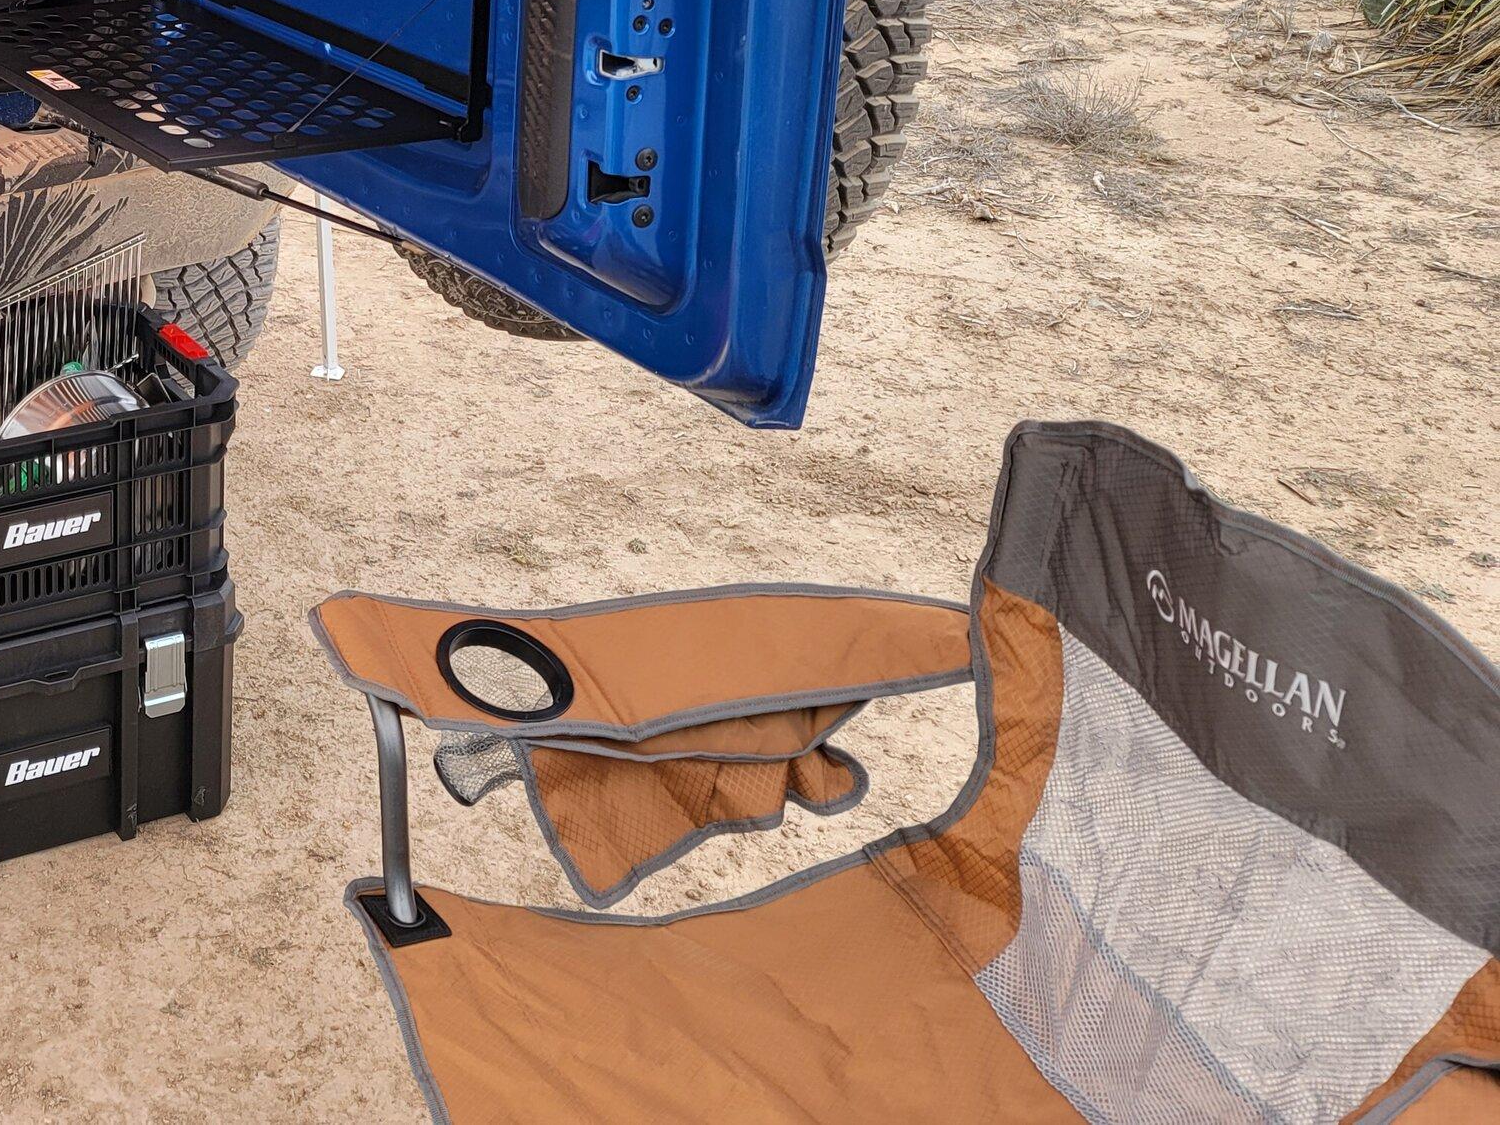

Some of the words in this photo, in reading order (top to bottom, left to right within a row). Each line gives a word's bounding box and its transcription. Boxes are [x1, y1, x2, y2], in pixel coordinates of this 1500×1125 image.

[3, 512, 101, 550] Bauer
[1178, 596, 1347, 728] MAGELLAN
[1180, 629, 1341, 748] OUTDOORS
[4, 747, 101, 787] Bauer
